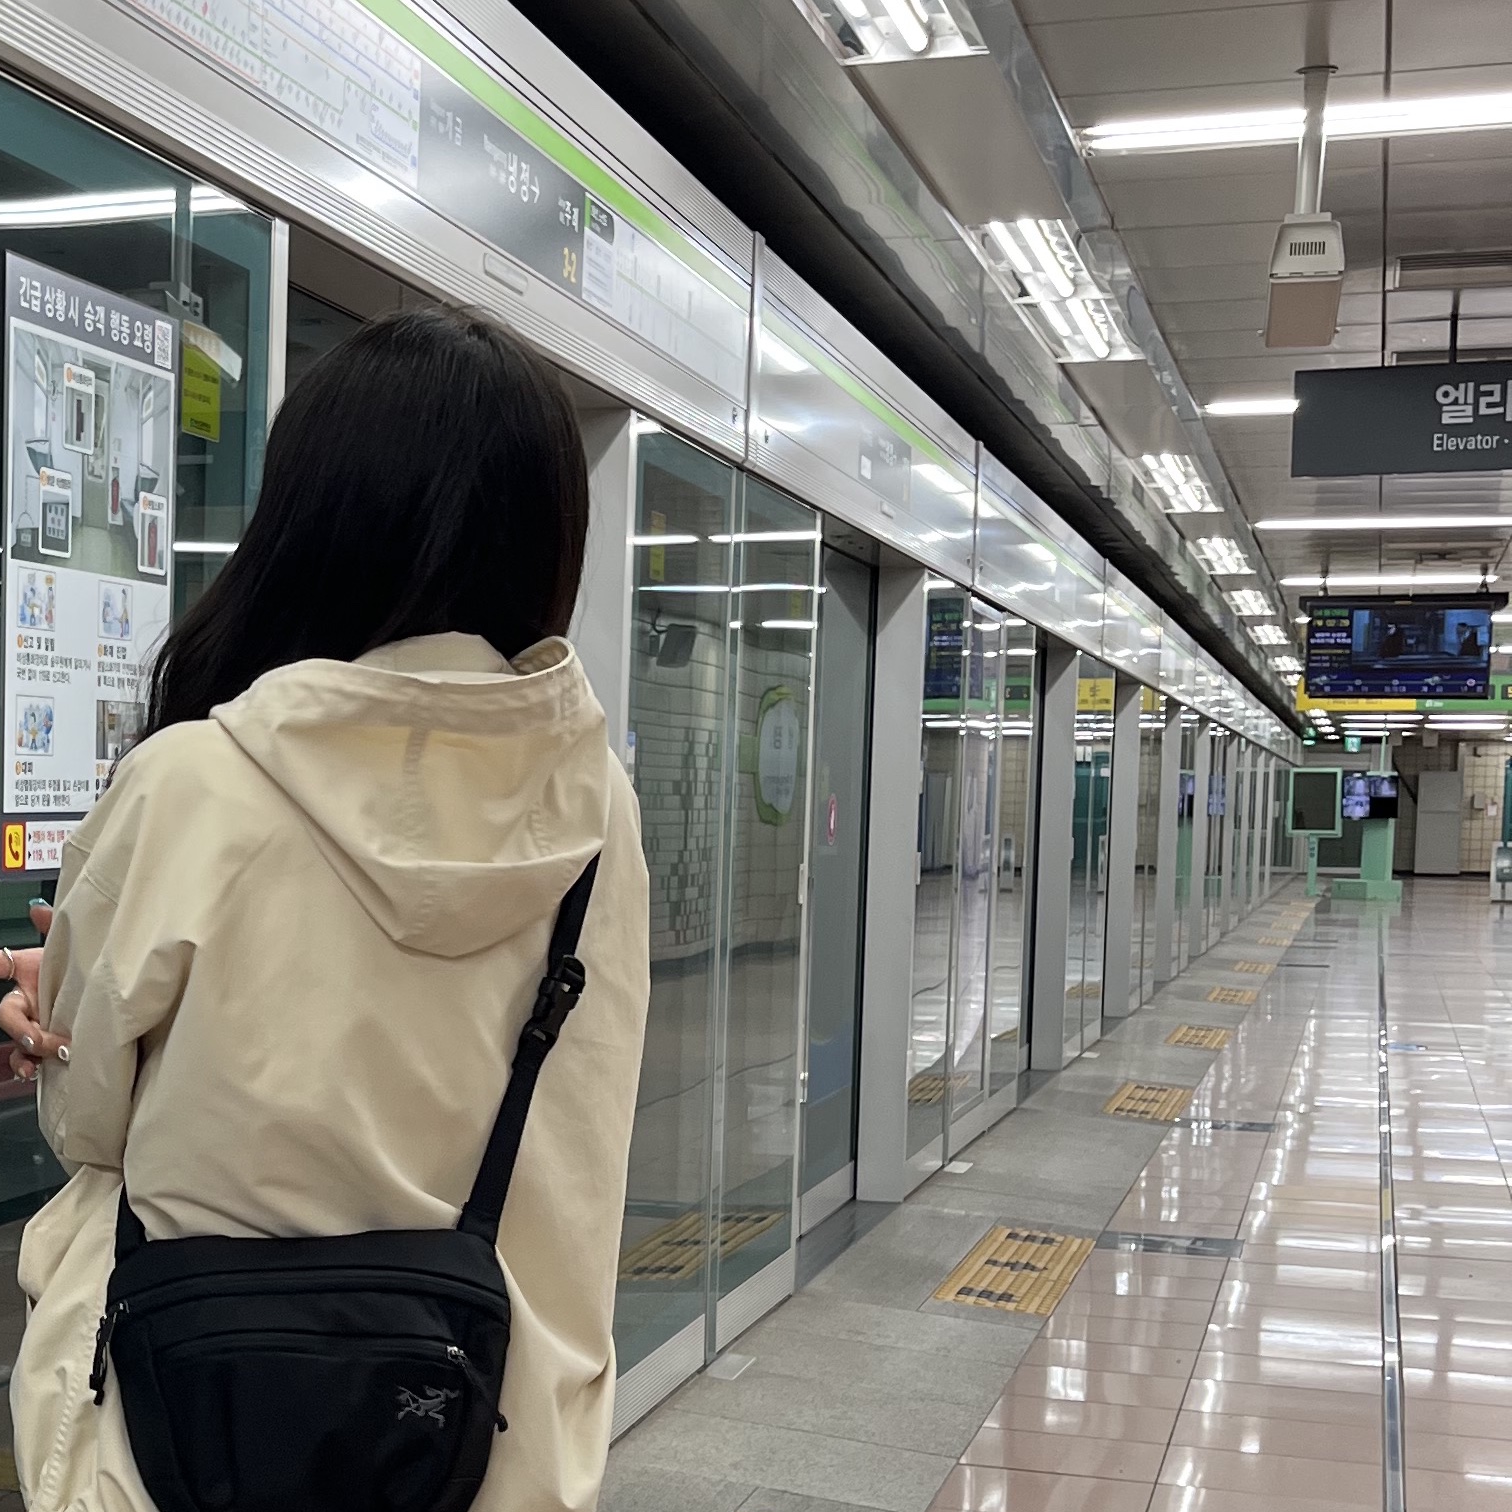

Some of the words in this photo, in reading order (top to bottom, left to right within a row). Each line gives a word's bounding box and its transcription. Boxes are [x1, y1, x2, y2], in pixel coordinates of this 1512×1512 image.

[507, 151, 530, 203] 냉정
[564, 200, 579, 233] 주례
[563, 247, 576, 283] 3-2
[84, 300, 105, 337] 승객
[110, 309, 130, 345] 행동
[133, 320, 152, 354] 요령
[1433, 433, 1500, 451] Elevator
[104, 644, 114, 657] 화재
[117, 646, 127, 659] 진압
[21, 761, 33, 775] 대피
[33, 848, 44, 862] 119,
[47, 848, 59, 862] 112,
